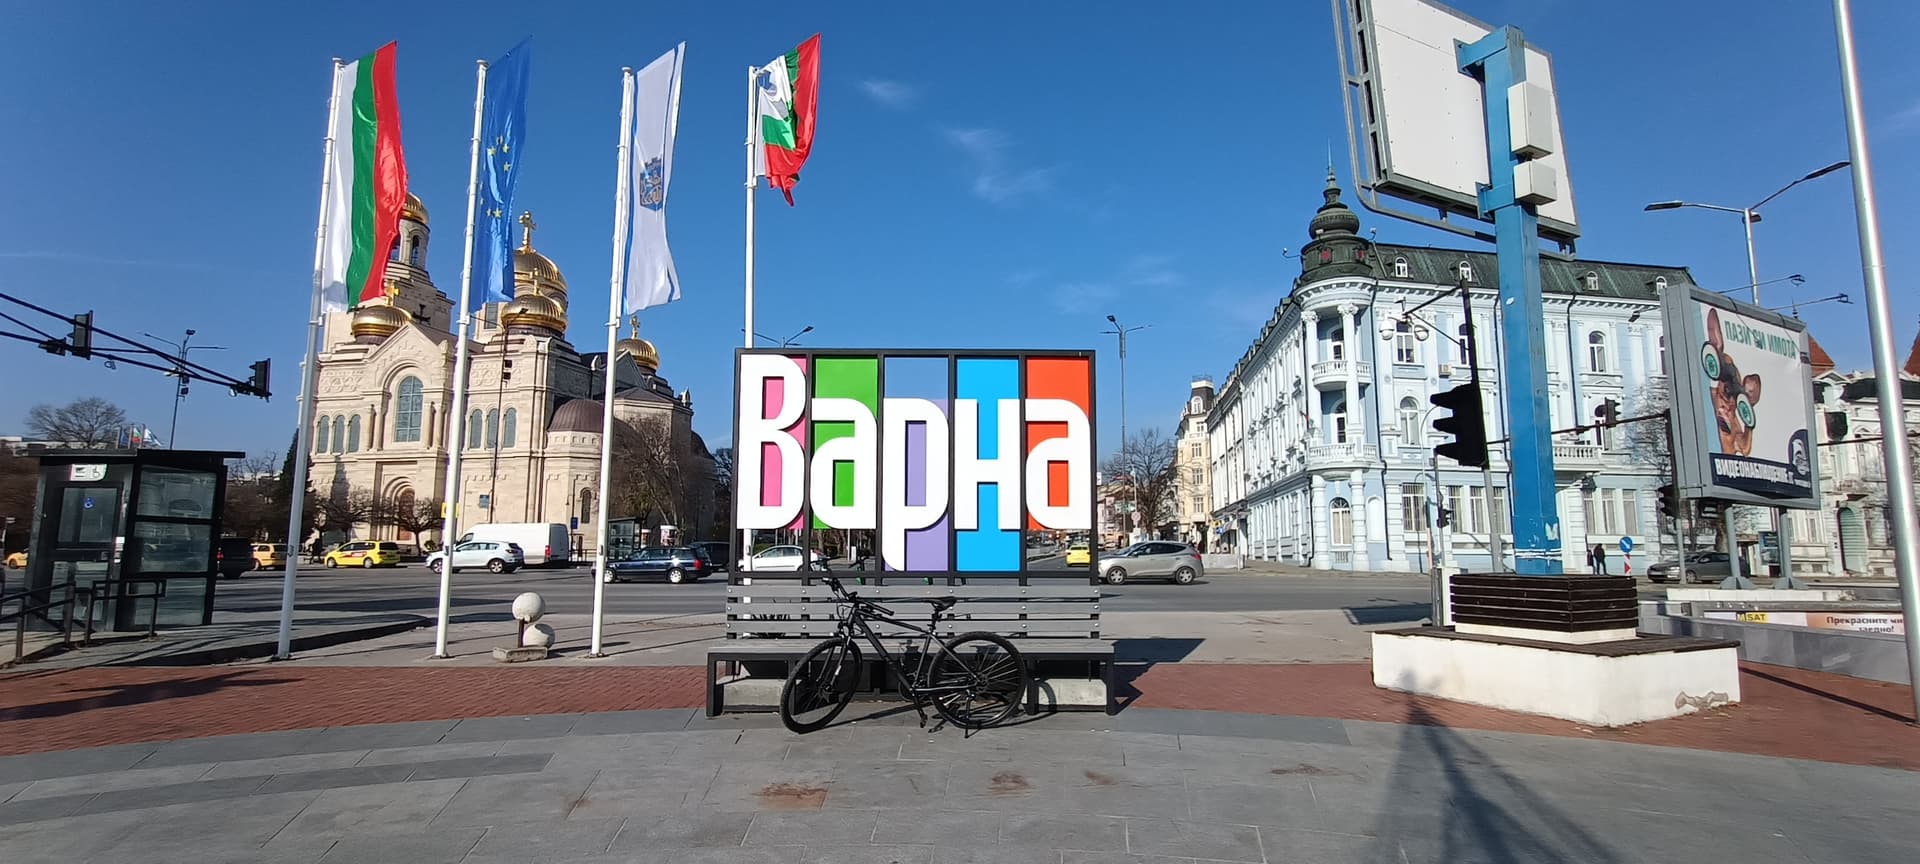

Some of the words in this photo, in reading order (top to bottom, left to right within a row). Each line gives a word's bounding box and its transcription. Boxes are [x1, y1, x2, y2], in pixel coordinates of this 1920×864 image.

[1724, 320, 1751, 346] ПАЗИ
[1767, 334, 1796, 359] ИМОТА
[736, 354, 1092, 571] Варна
